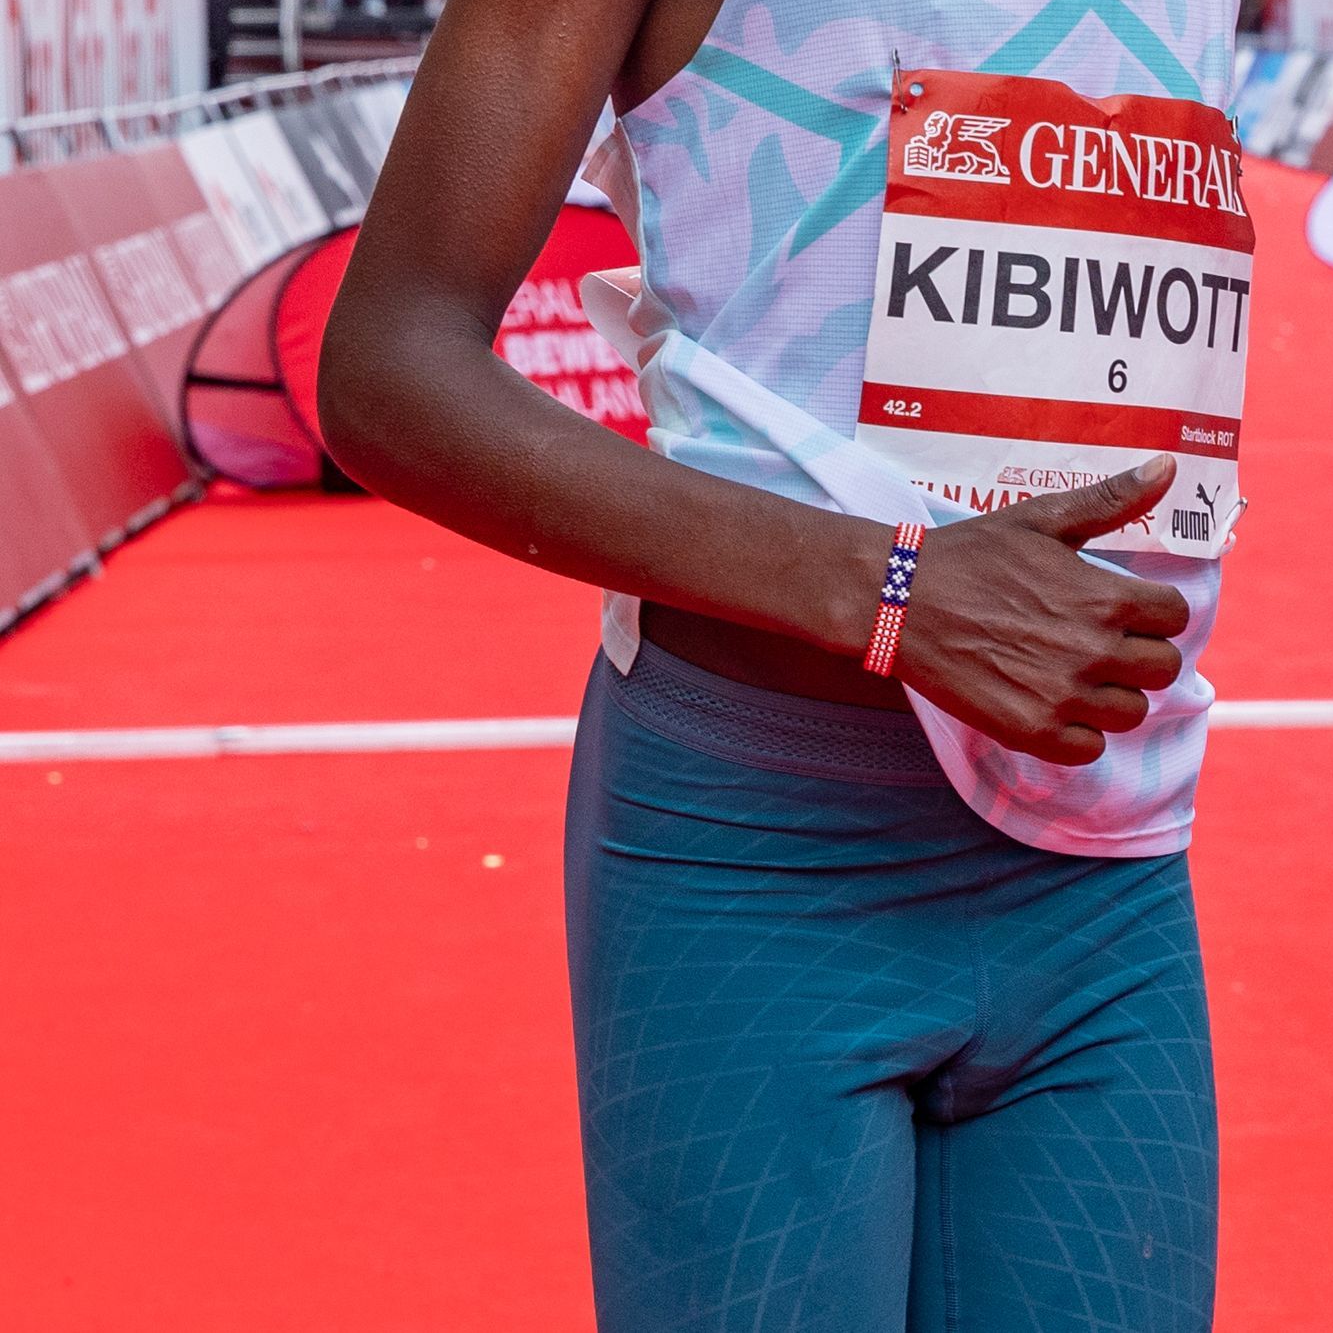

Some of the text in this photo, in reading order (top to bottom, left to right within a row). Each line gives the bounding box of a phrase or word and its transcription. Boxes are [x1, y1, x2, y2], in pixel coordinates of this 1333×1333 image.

[886, 242, 1250, 353] KIBIWOTT
[1107, 358, 1129, 394] 6
[883, 399, 922, 418] 42.2
[1181, 424, 1235, 448] Startblock ROT
[1029, 468, 1111, 490] GENERA
[1172, 508, 1210, 542] PUMA
